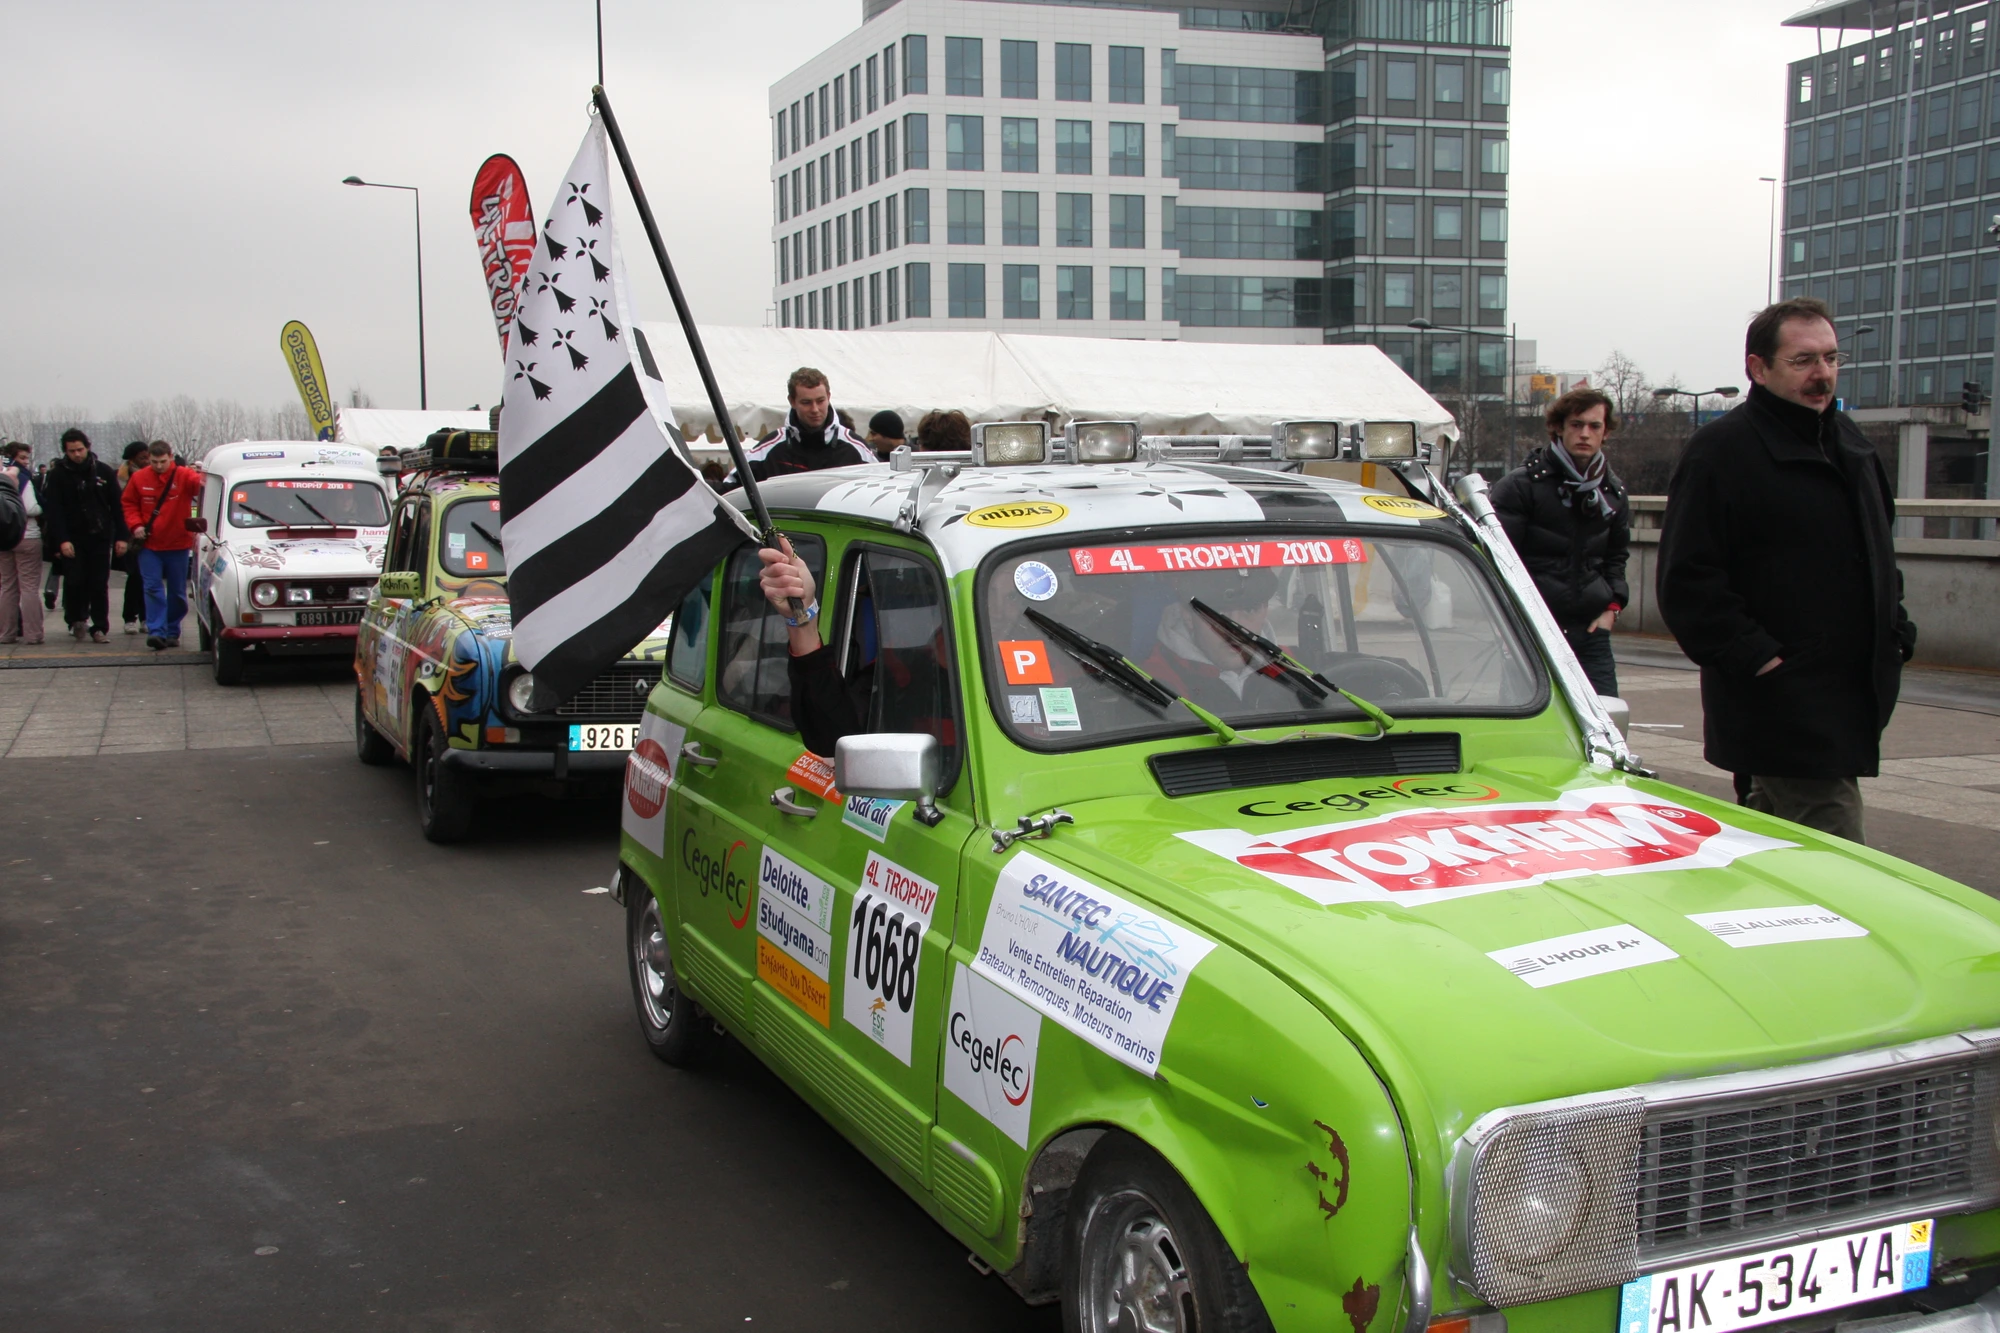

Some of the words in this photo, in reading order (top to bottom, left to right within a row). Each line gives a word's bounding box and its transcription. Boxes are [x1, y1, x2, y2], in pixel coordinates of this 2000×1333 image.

[287, 329, 331, 423] DESERTOURS
[471, 555, 482, 566] P
[1109, 549, 1145, 571] 4L
[1157, 544, 1261, 570] TROPHY
[1277, 541, 1333, 565] 2010
[301, 612, 329, 625] 8891
[332, 612, 345, 624] YJ
[347, 611, 360, 623] 77
[1013, 650, 1036, 675] P
[586, 727, 624, 749] 926
[789, 765, 804, 778] SCHOOL
[808, 773, 828, 787] BUSINESS
[795, 755, 813, 769] ESC
[808, 760, 835, 780] RENNES
[848, 795, 875, 819] Sidi
[871, 804, 892, 827] ali
[1237, 784, 1479, 817] Cegelec
[1297, 804, 1699, 894] TOKHEIM
[1408, 846, 1671, 885] QUALITY
[682, 827, 746, 909] Cegelec
[865, 859, 880, 887] 4L
[885, 867, 936, 915] TROPHY
[1023, 873, 1112, 928] SANTEC
[995, 902, 1014, 924] Bruno
[1737, 915, 1819, 931] LALLINEC
[1819, 915, 1842, 925] B+
[760, 901, 829, 969] Studyrama.com
[853, 893, 921, 1013] 1668
[1536, 943, 1614, 966] L'HOUR
[1614, 937, 1641, 952] A+
[760, 945, 788, 981] Enfants
[790, 969, 800, 991] du
[802, 974, 826, 1010] Désert
[1008, 938, 1033, 965] Vente
[1034, 954, 1076, 990] Entretien
[1077, 978, 1132, 1024] Réparation
[1056, 931, 1175, 1012] NAUTIQUE
[872, 1011, 885, 1032] ESC
[980, 946, 1015, 982] Bateaux,
[1017, 968, 1070, 1016] Remorques,
[1073, 1002, 1114, 1040] Moteurs
[1114, 1032, 1156, 1064] marins
[950, 1012, 1023, 1090] Cegelec
[1656, 1231, 1894, 1333] AK-534-YA
[1904, 1258, 1924, 1284] 88
